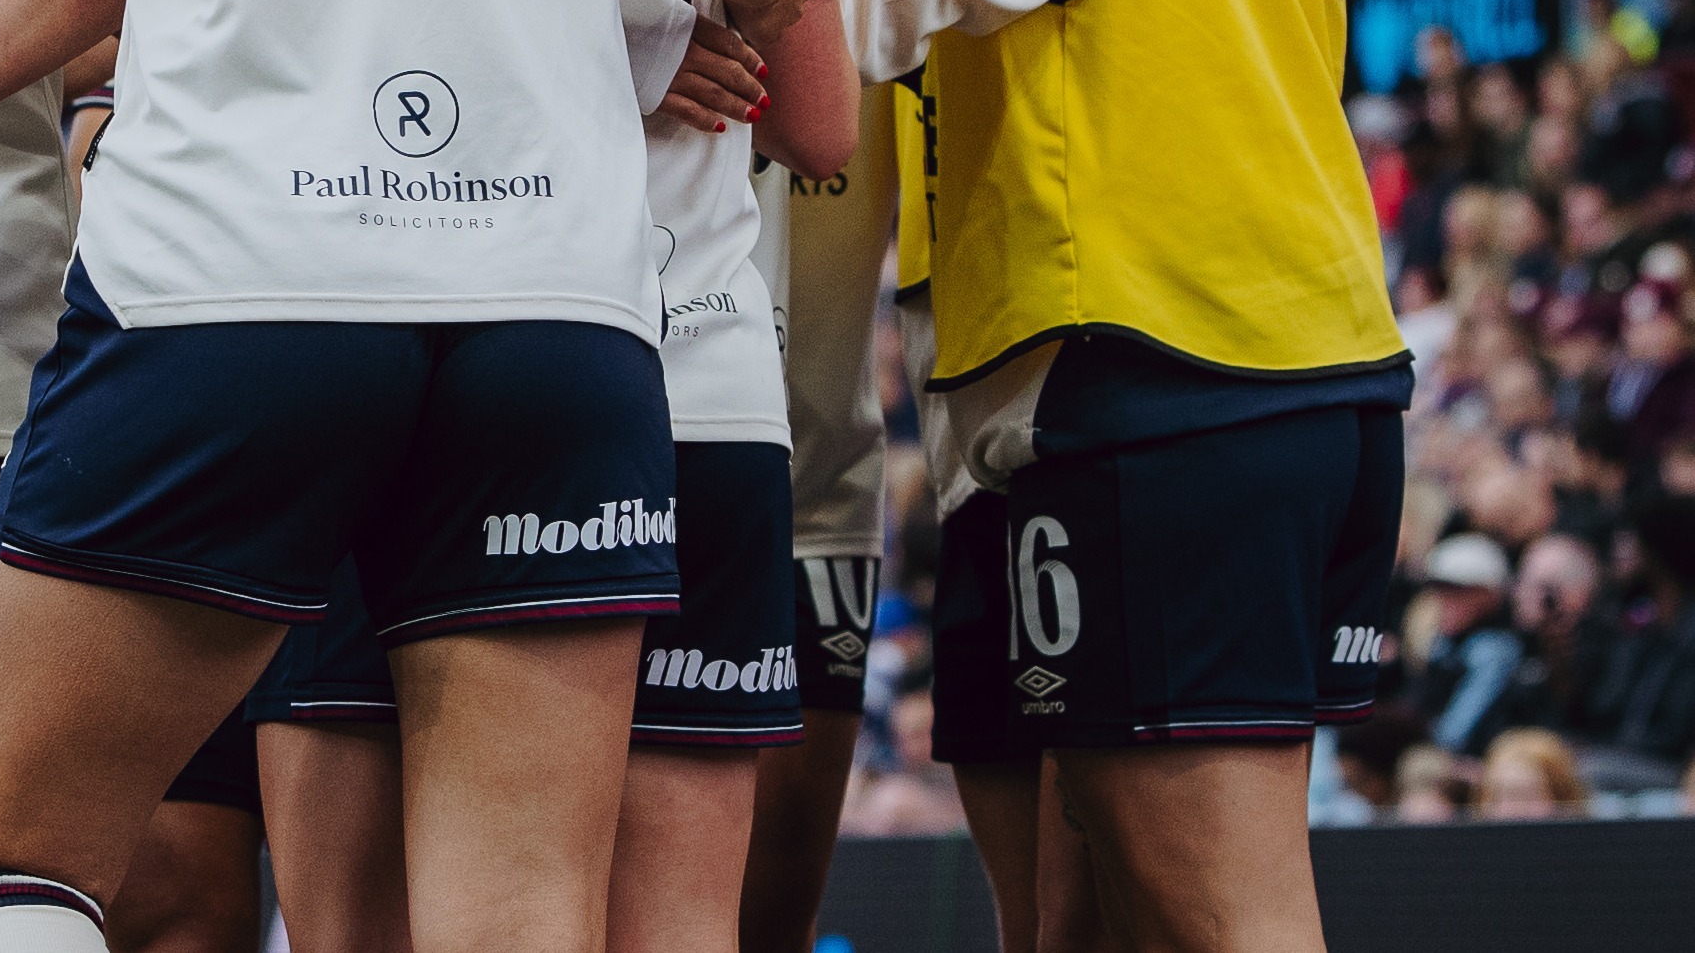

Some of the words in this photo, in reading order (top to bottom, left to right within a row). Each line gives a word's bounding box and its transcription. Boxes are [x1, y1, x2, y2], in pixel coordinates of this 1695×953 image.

[290, 165, 372, 196] Paul
[380, 169, 554, 203] Robinson
[359, 212, 494, 229] SOLICITORS
[483, 497, 676, 556] Modibod
[1022, 699, 1067, 715] umbro
